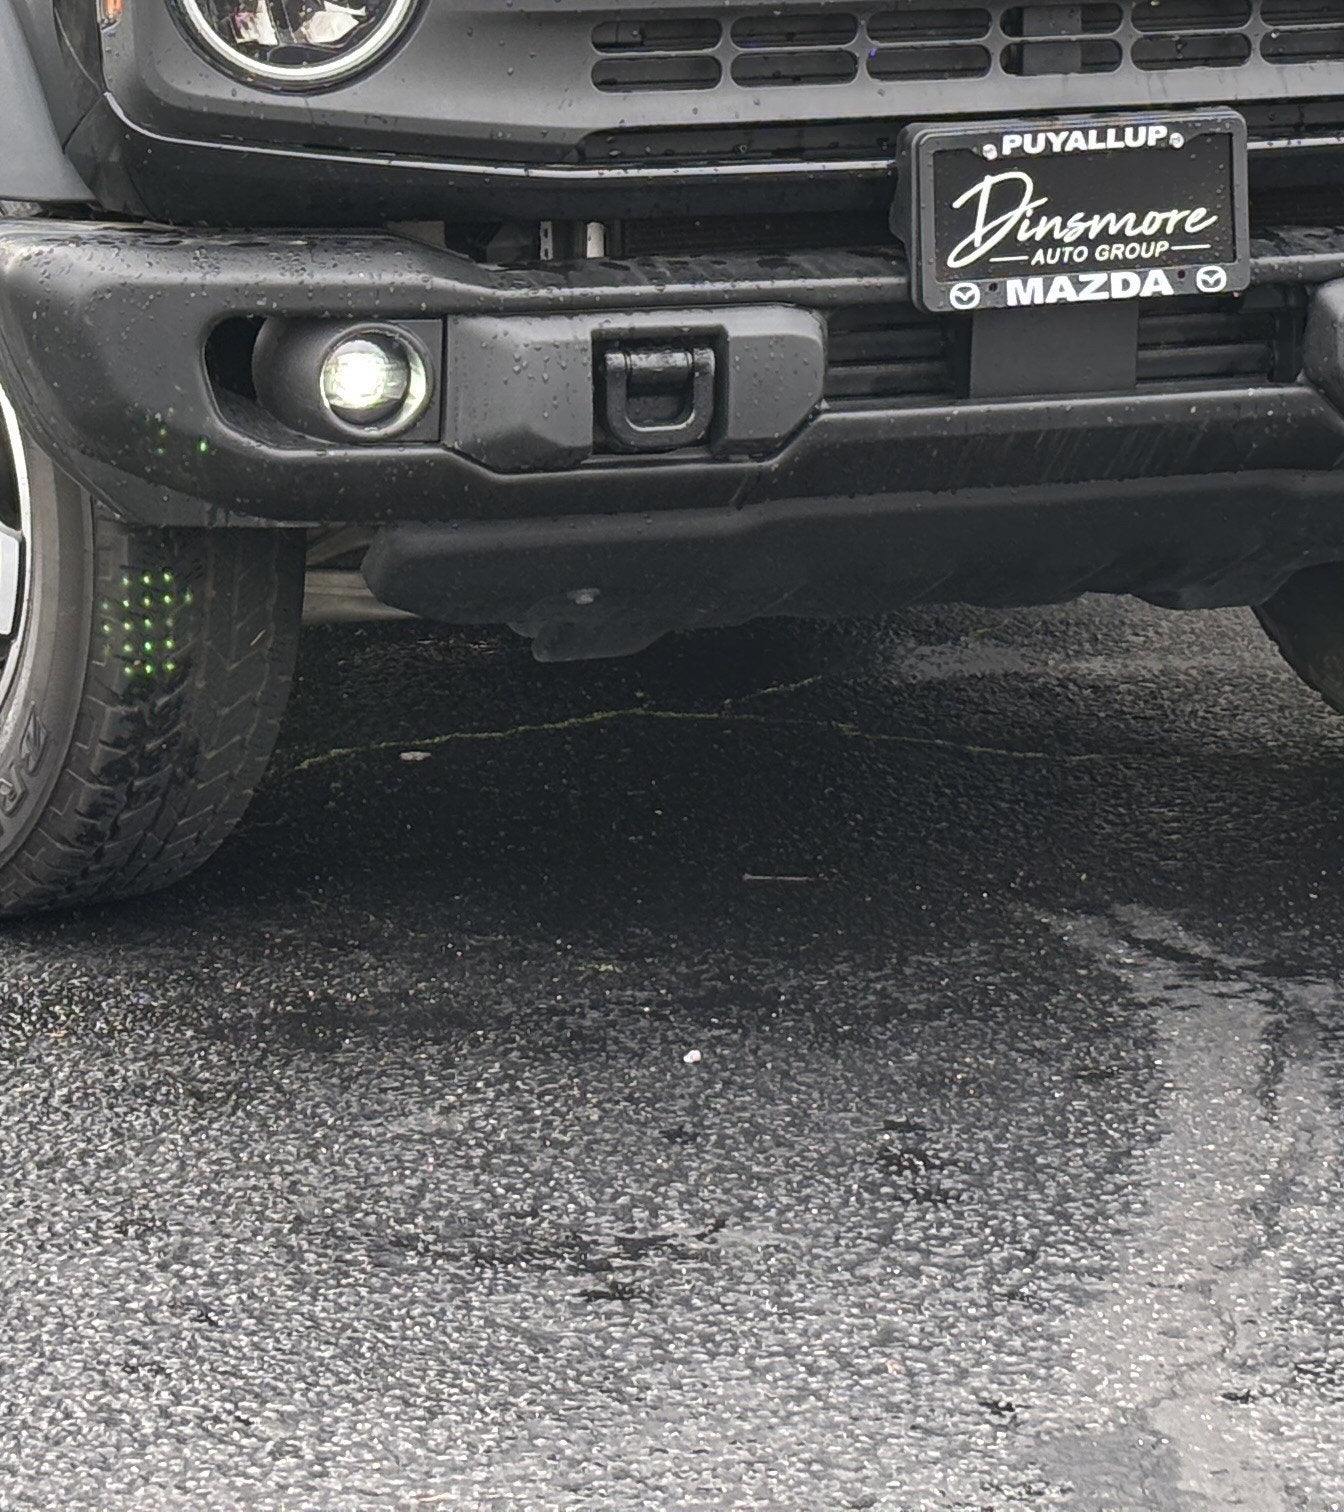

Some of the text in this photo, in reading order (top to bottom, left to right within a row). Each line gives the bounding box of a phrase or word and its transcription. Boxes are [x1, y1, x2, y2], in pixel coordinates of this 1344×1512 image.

[1002, 125, 1169, 156] PUYALLUP
[946, 170, 1219, 269] Dinsmore
[1031, 240, 1170, 266] AUTO GROUP
[1006, 269, 1174, 307] MAZDA
